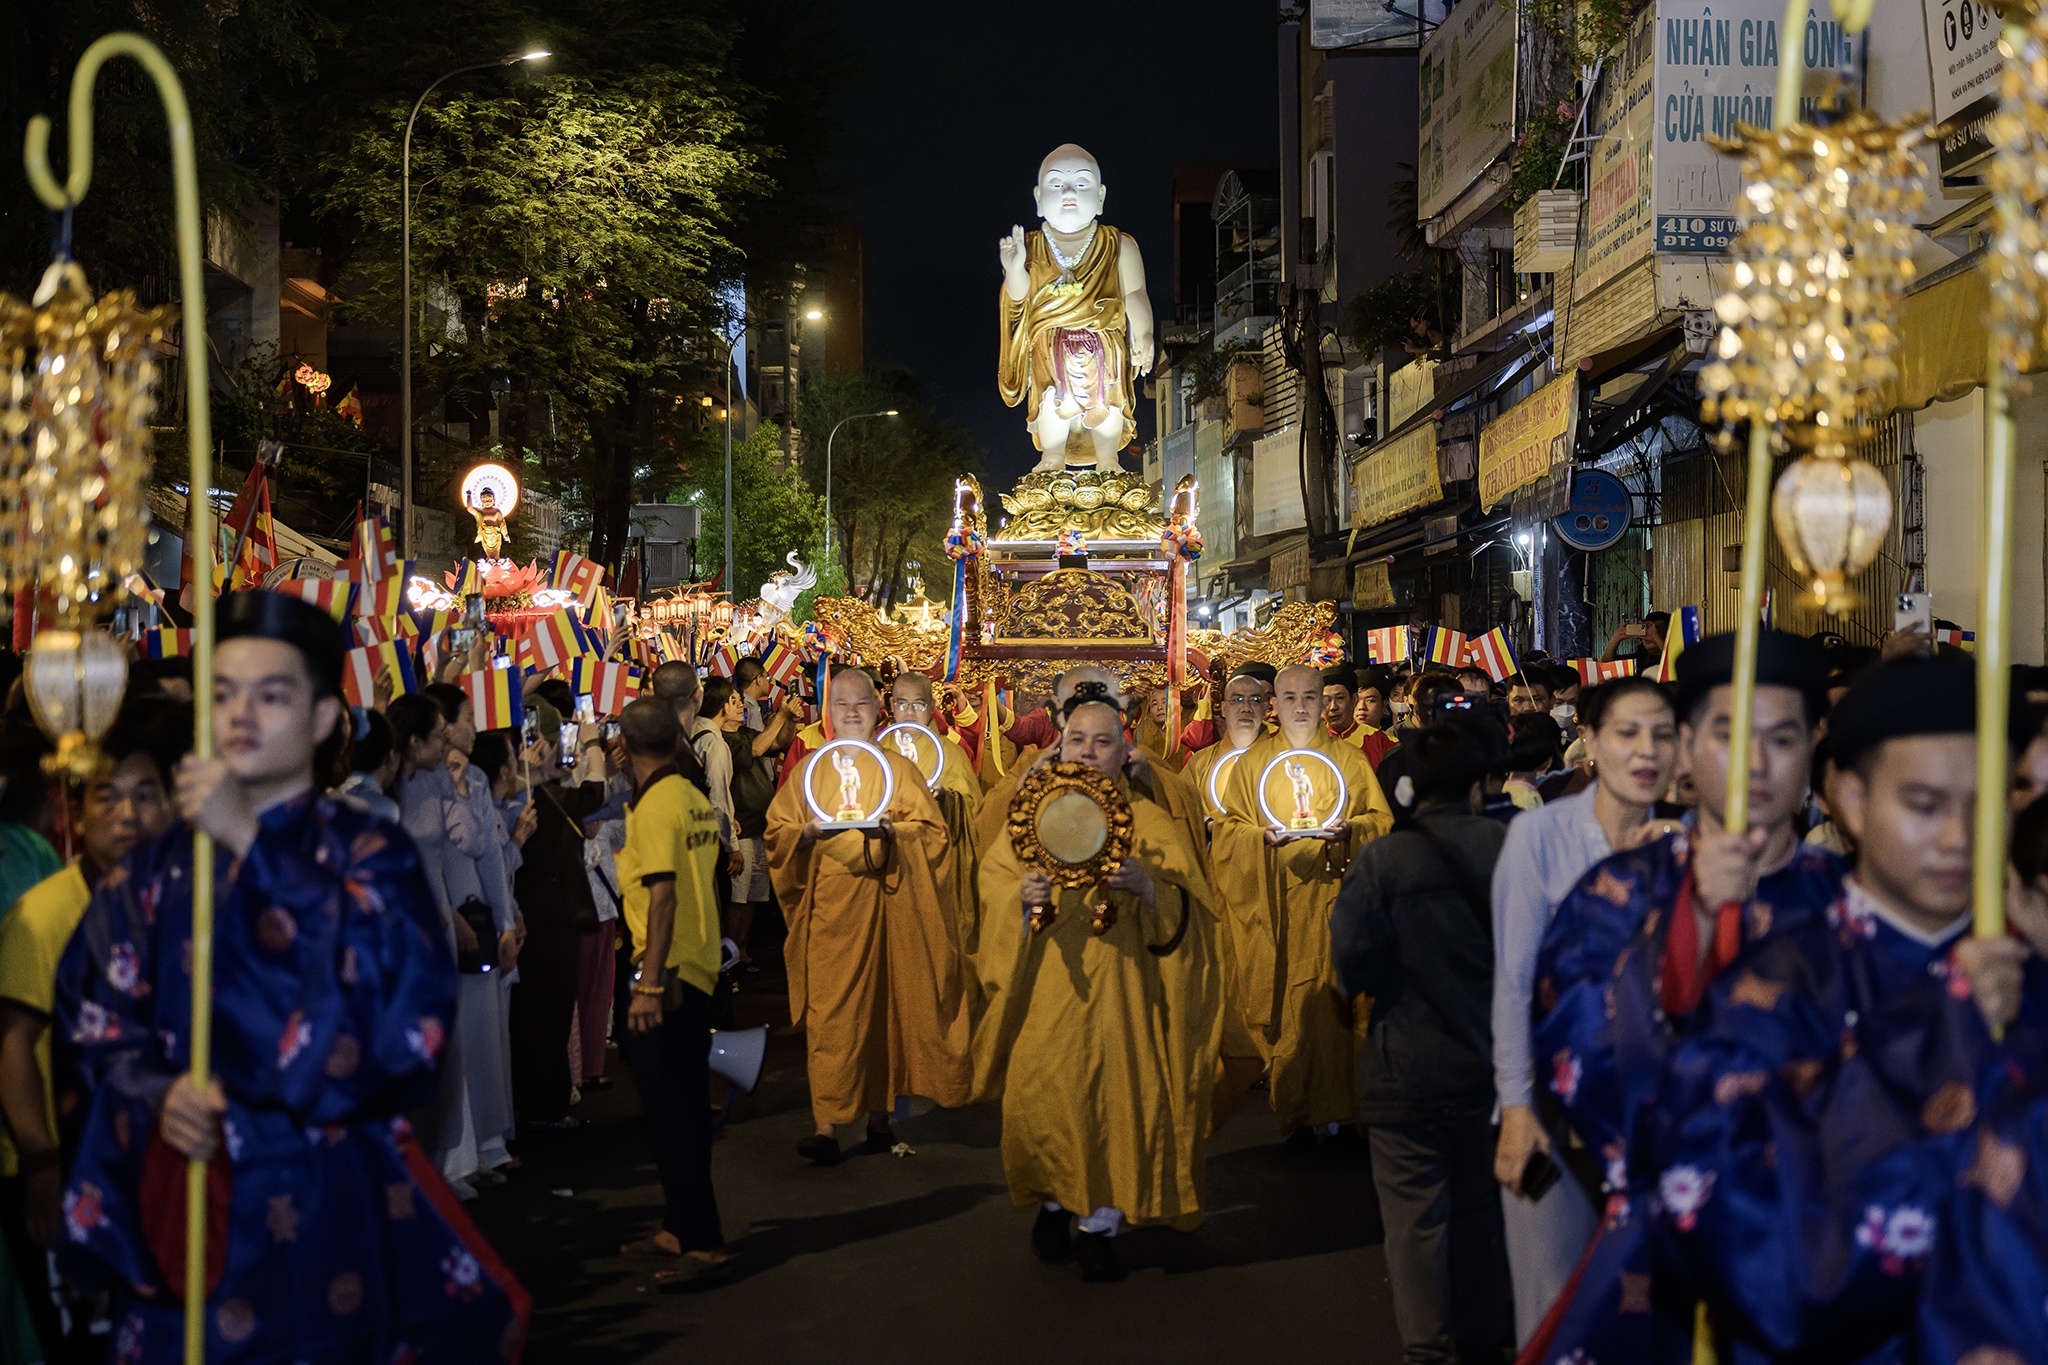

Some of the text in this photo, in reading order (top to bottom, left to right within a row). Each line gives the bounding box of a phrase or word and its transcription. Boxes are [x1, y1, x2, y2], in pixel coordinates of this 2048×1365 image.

[1666, 6, 1730, 77] NHẬN
[1740, 19, 1778, 67] GIA
[1803, 9, 1851, 68] ÔNG
[1665, 80, 1704, 142] CỬA
[1712, 84, 1772, 142] NHÔM
[1957, 127, 1967, 147] SƯ
[1661, 218, 1706, 234] 410
[1710, 220, 1726, 233] SƯ
[1663, 235, 1696, 246] ĐT:
[1483, 454, 1518, 499] THÀNH
[1519, 434, 1550, 481] NHÂN
